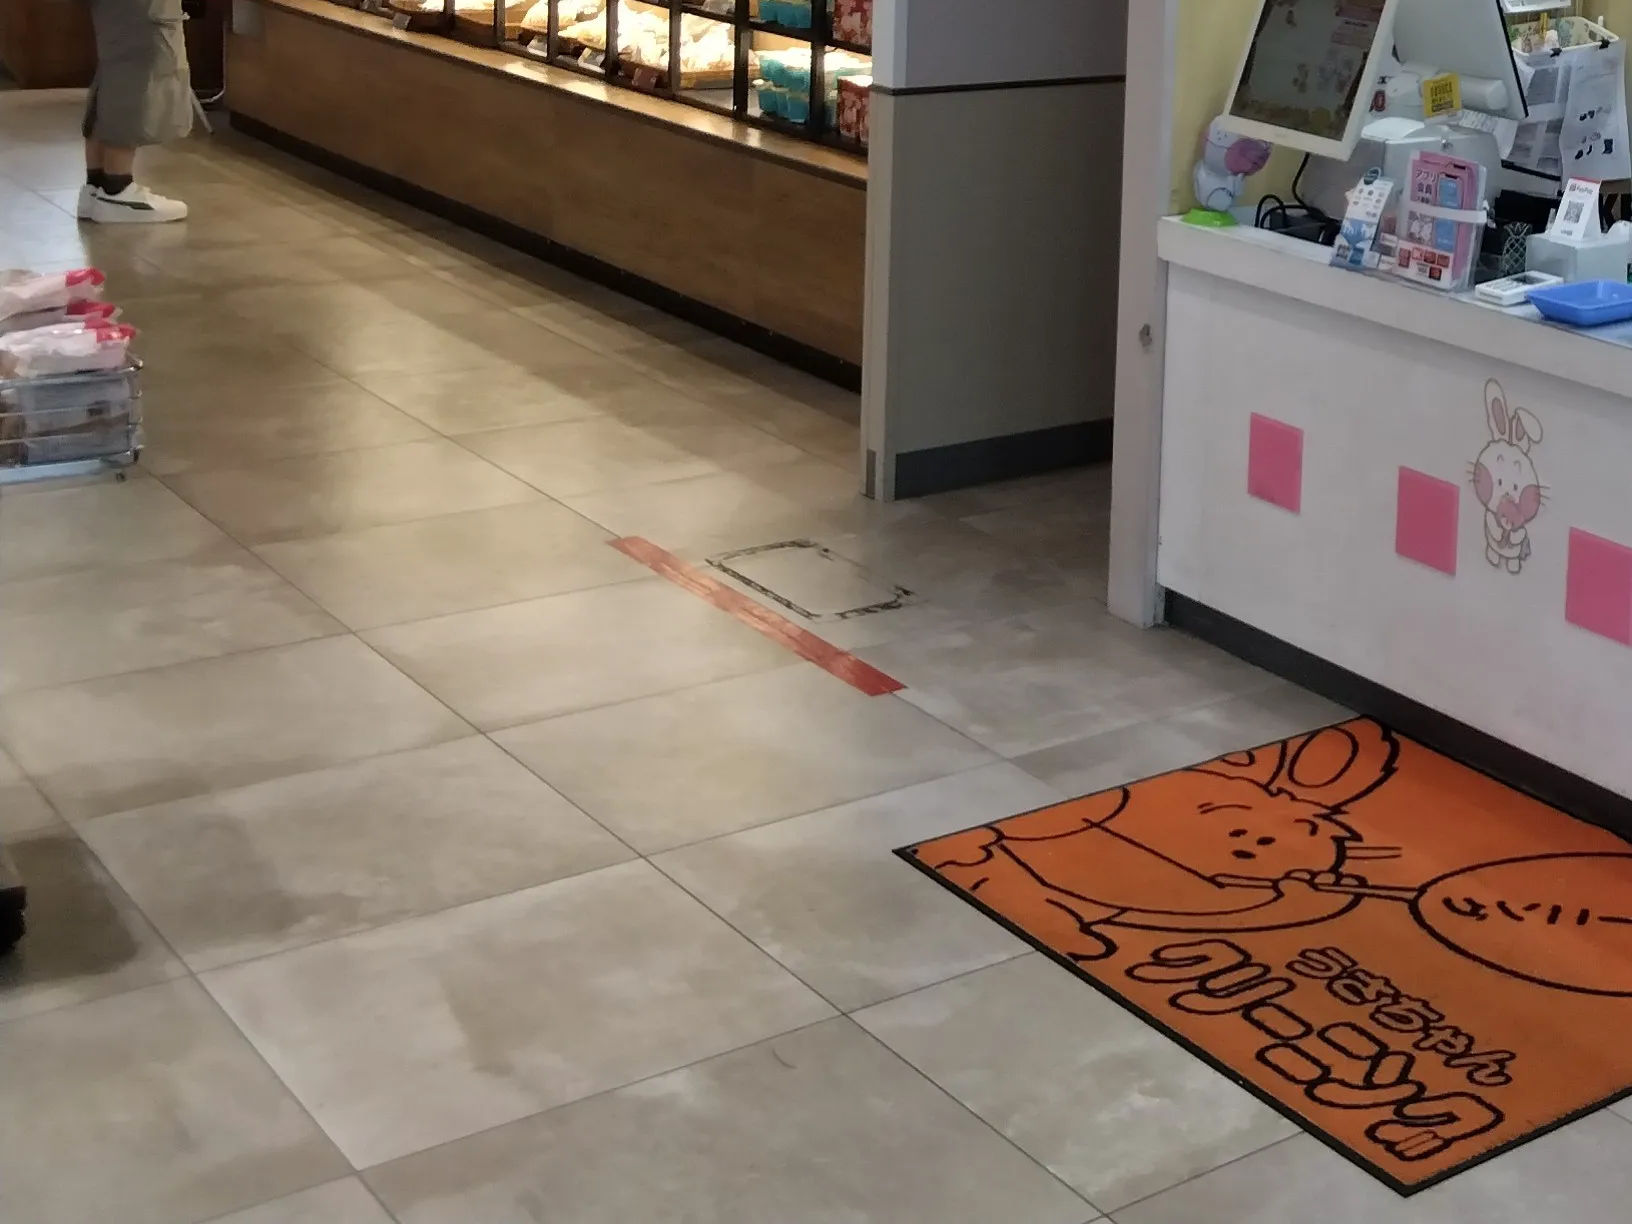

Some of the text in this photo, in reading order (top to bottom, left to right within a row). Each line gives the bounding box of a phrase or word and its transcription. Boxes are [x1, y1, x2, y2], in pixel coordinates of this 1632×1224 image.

[1125, 939, 1504, 1162] クリーニング
[1286, 945, 1516, 1086] うさちゃん
